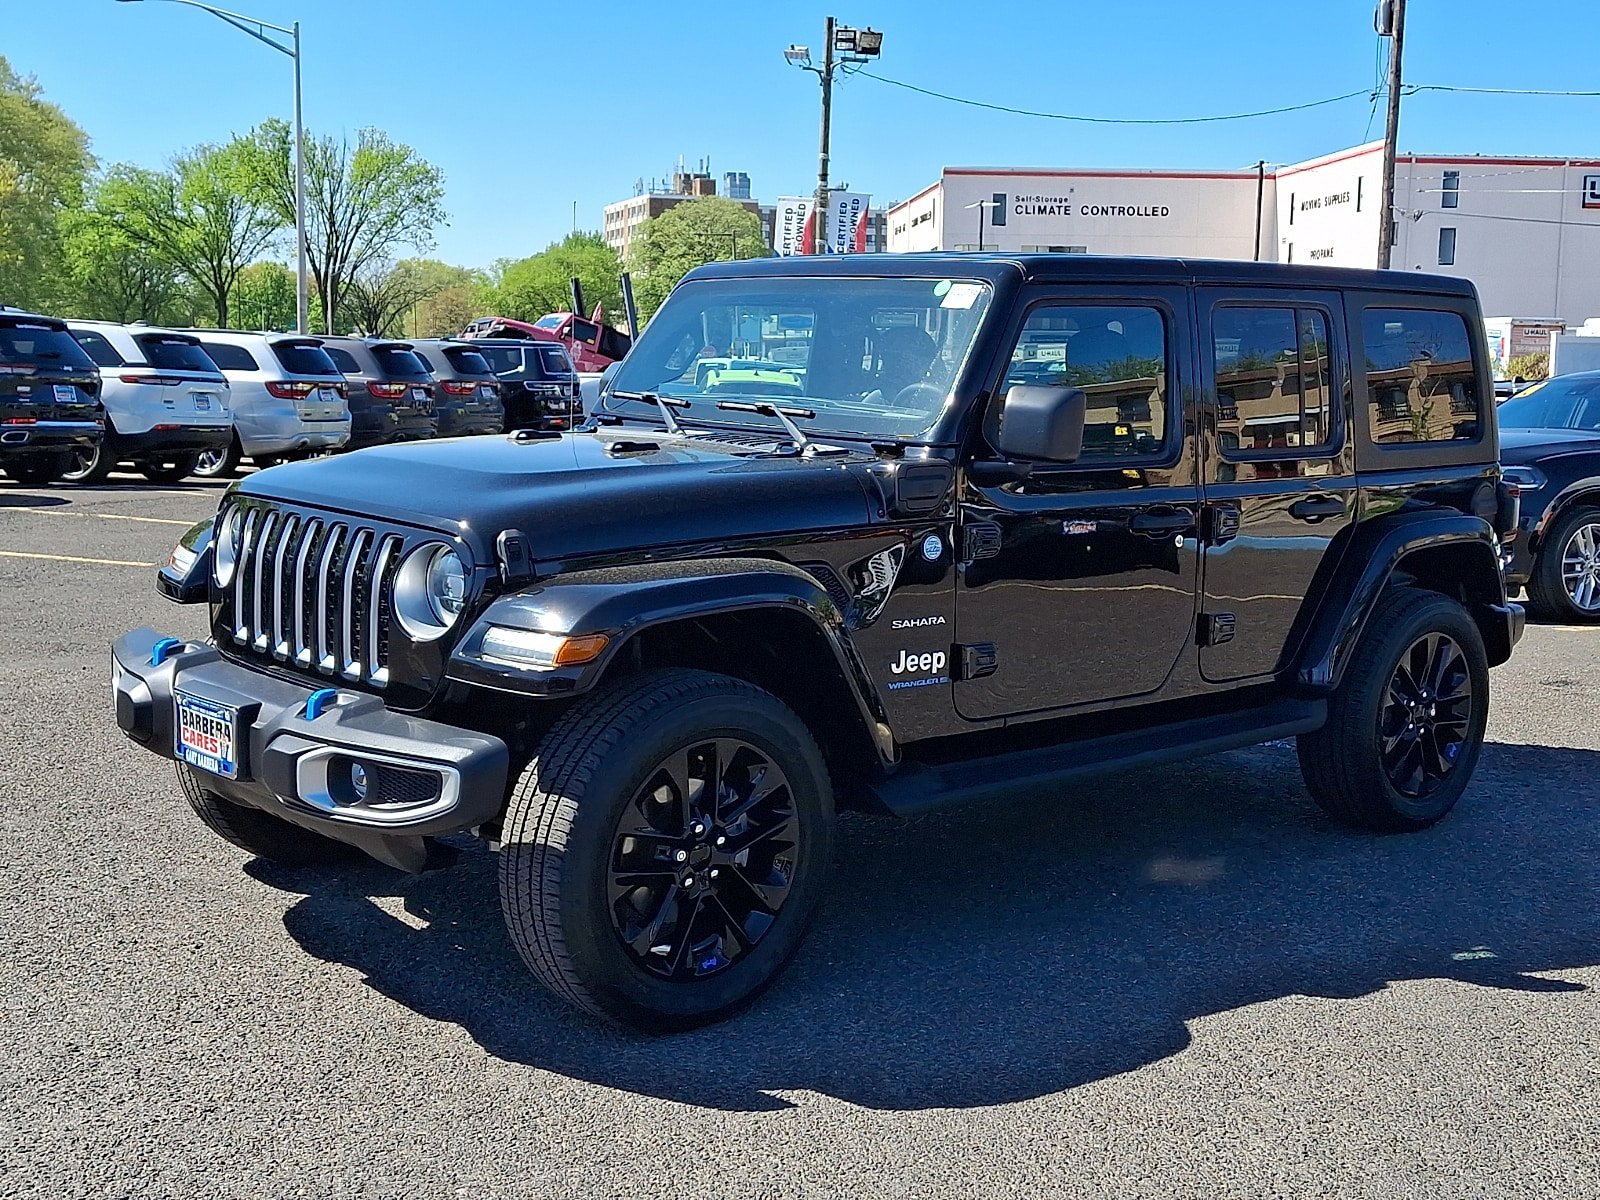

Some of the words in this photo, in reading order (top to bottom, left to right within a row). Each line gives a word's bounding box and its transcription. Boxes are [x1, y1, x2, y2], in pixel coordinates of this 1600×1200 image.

[1015, 195, 1069, 203] Self-Storage
[1324, 191, 1350, 207] SUPPLIES
[1014, 205, 1071, 216] CLIMATE
[1080, 205, 1170, 217] CONTROLLED
[783, 207, 793, 257] ERTIFIED
[837, 201, 847, 254] CERTIFIED
[892, 616, 946, 629] SAHARA
[891, 650, 946, 674] Jeep
[888, 678, 939, 690] WRANGLER
[181, 708, 231, 742] BARBERA
[182, 726, 218, 753] CARES
